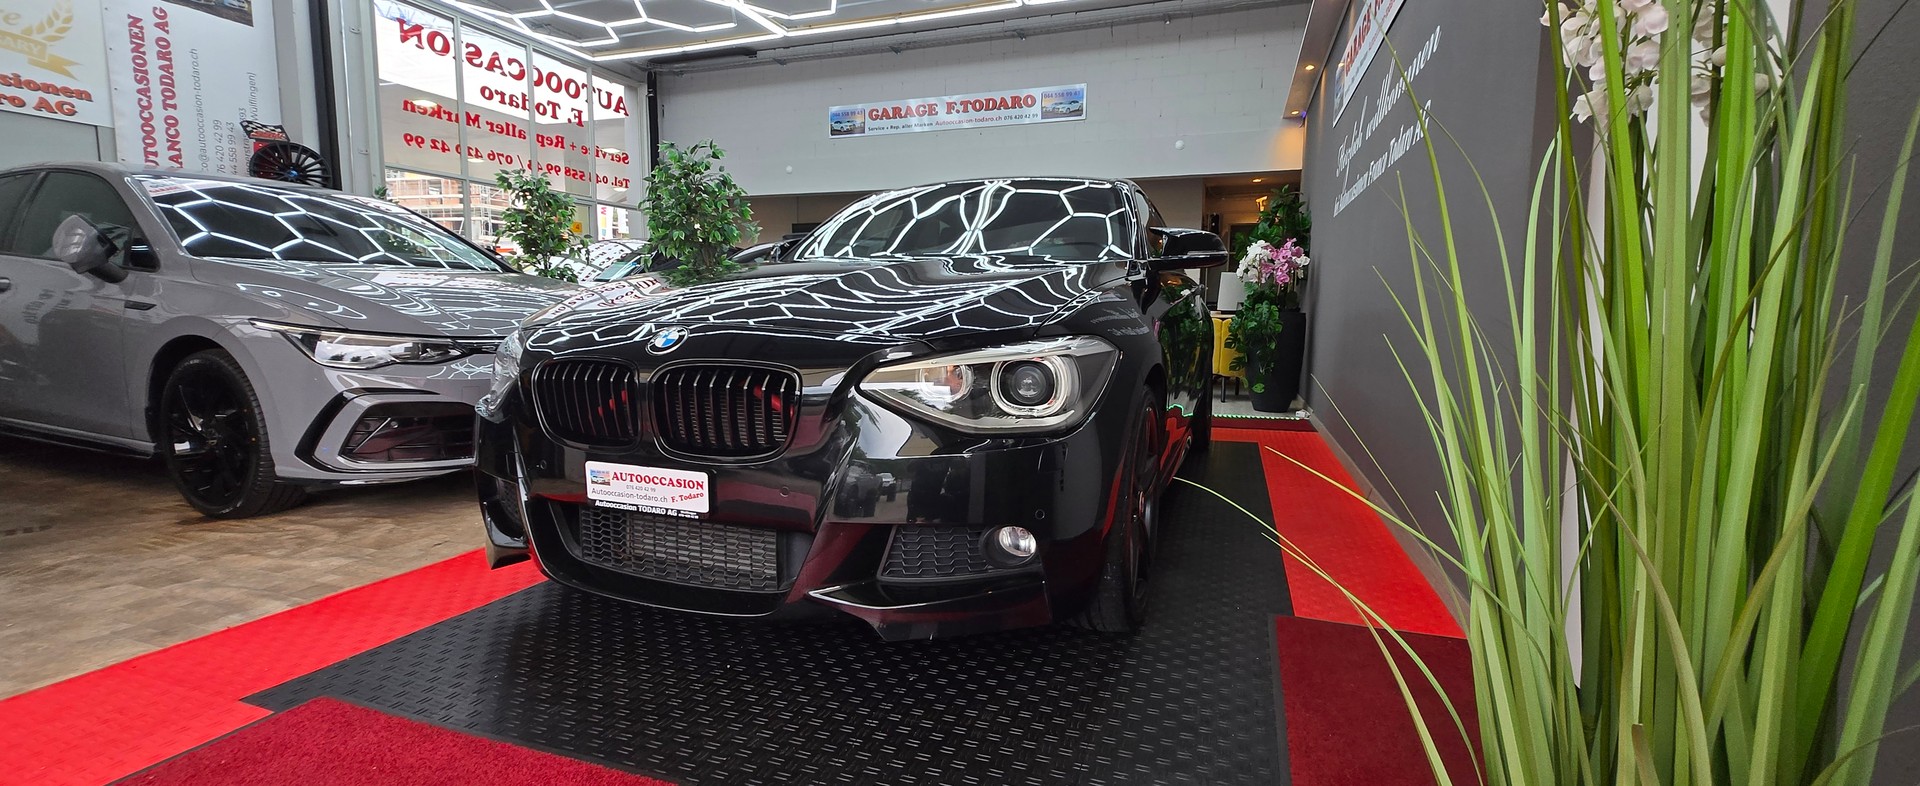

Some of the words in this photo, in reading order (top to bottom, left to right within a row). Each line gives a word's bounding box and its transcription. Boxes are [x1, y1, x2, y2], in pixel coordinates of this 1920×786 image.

[152, 6, 170, 35] AG
[156, 37, 177, 111] TODARO
[32, 96, 78, 117] AG
[868, 103, 938, 121] GARAGE
[946, 94, 1037, 114] F.TODARO
[212, 119, 222, 131] 99
[226, 121, 235, 133] 43
[213, 131, 223, 144] 42
[227, 134, 237, 146] 99
[214, 144, 225, 162] 420
[228, 146, 238, 163] 558
[612, 471, 704, 490] AUTOOCCASION
[591, 487, 668, 503] Autooccasion-todaro.ch
[679, 491, 704, 502] Todaro
[595, 500, 637, 511] Autooccasion
[638, 505, 665, 515] TODARO
[667, 509, 678, 517] AG
